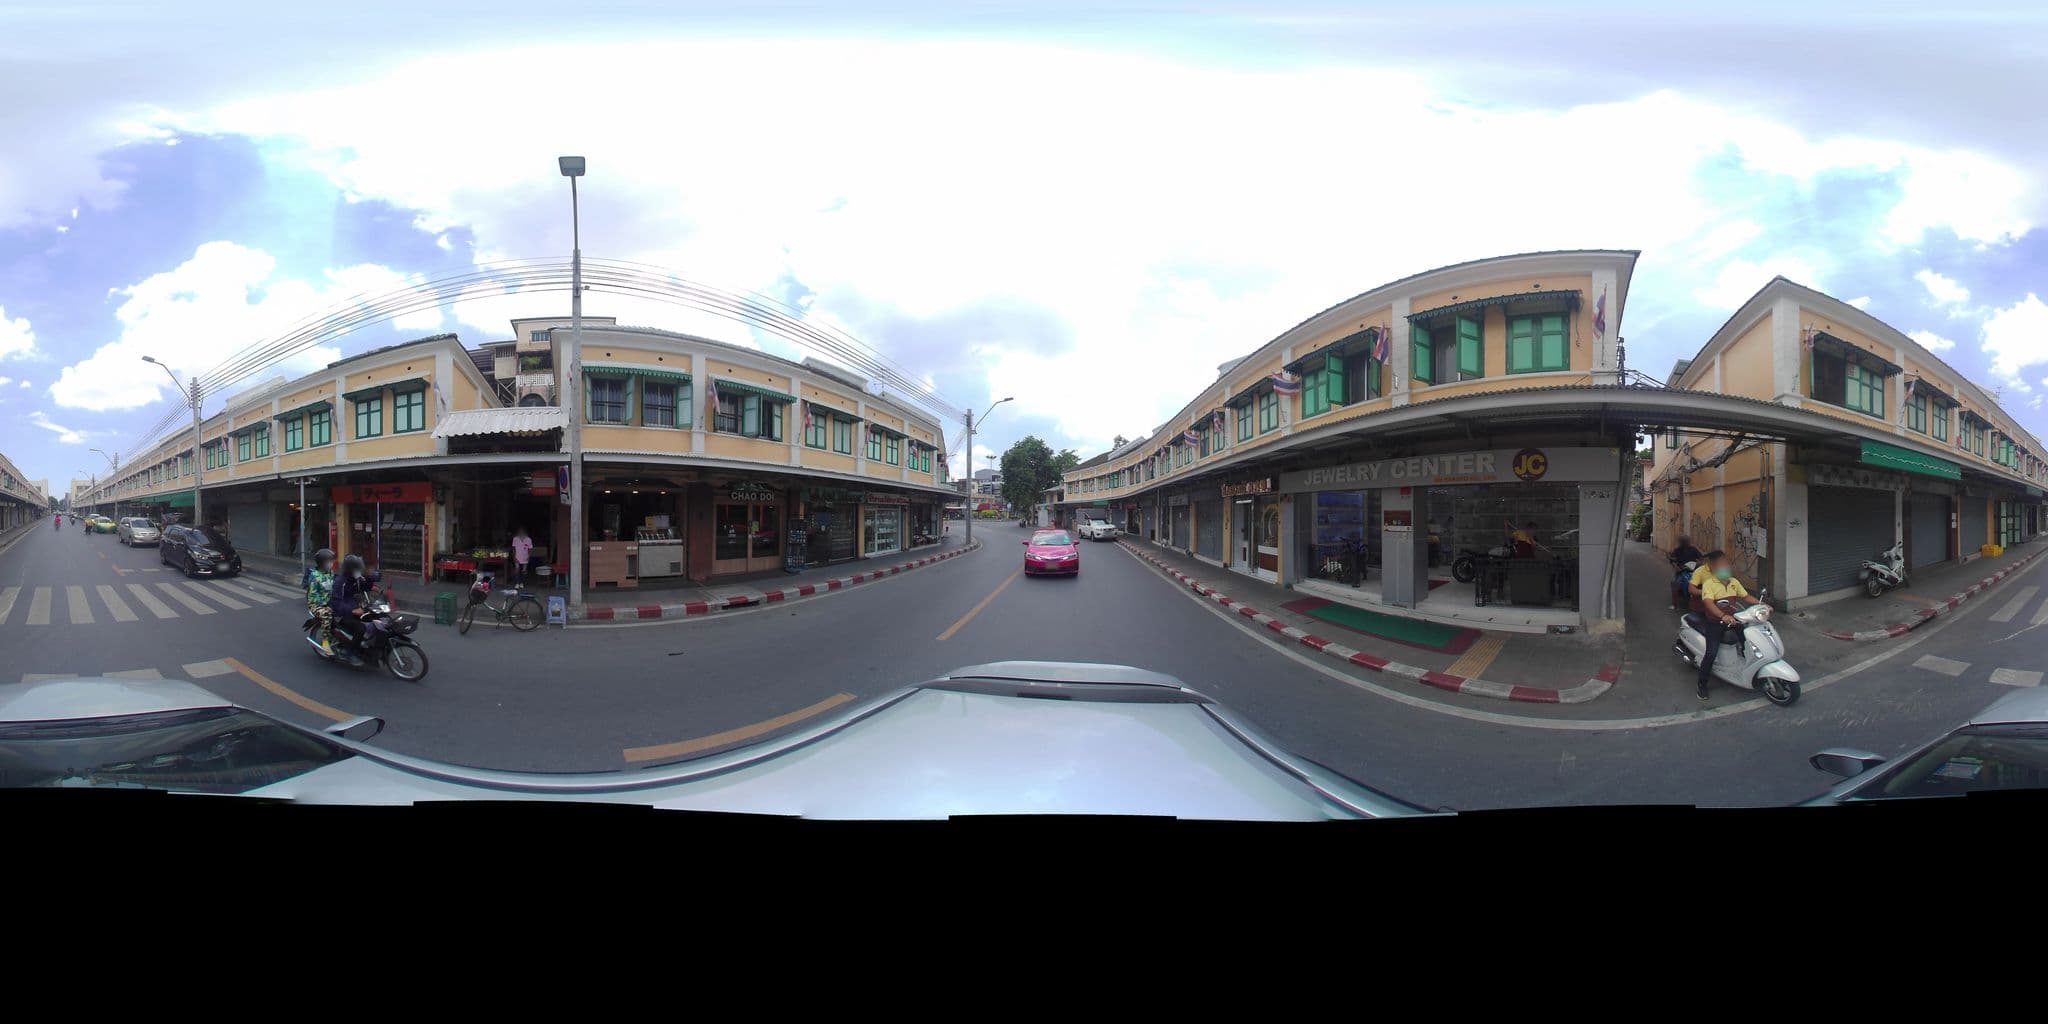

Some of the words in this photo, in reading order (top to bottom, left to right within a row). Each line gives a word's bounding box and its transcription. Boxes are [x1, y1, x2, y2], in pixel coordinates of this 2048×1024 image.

[1303, 462, 1383, 486] JEWELRY
[1390, 453, 1496, 479] CENTER
[1514, 454, 1546, 475] JC
[730, 491, 757, 501] CHAO
